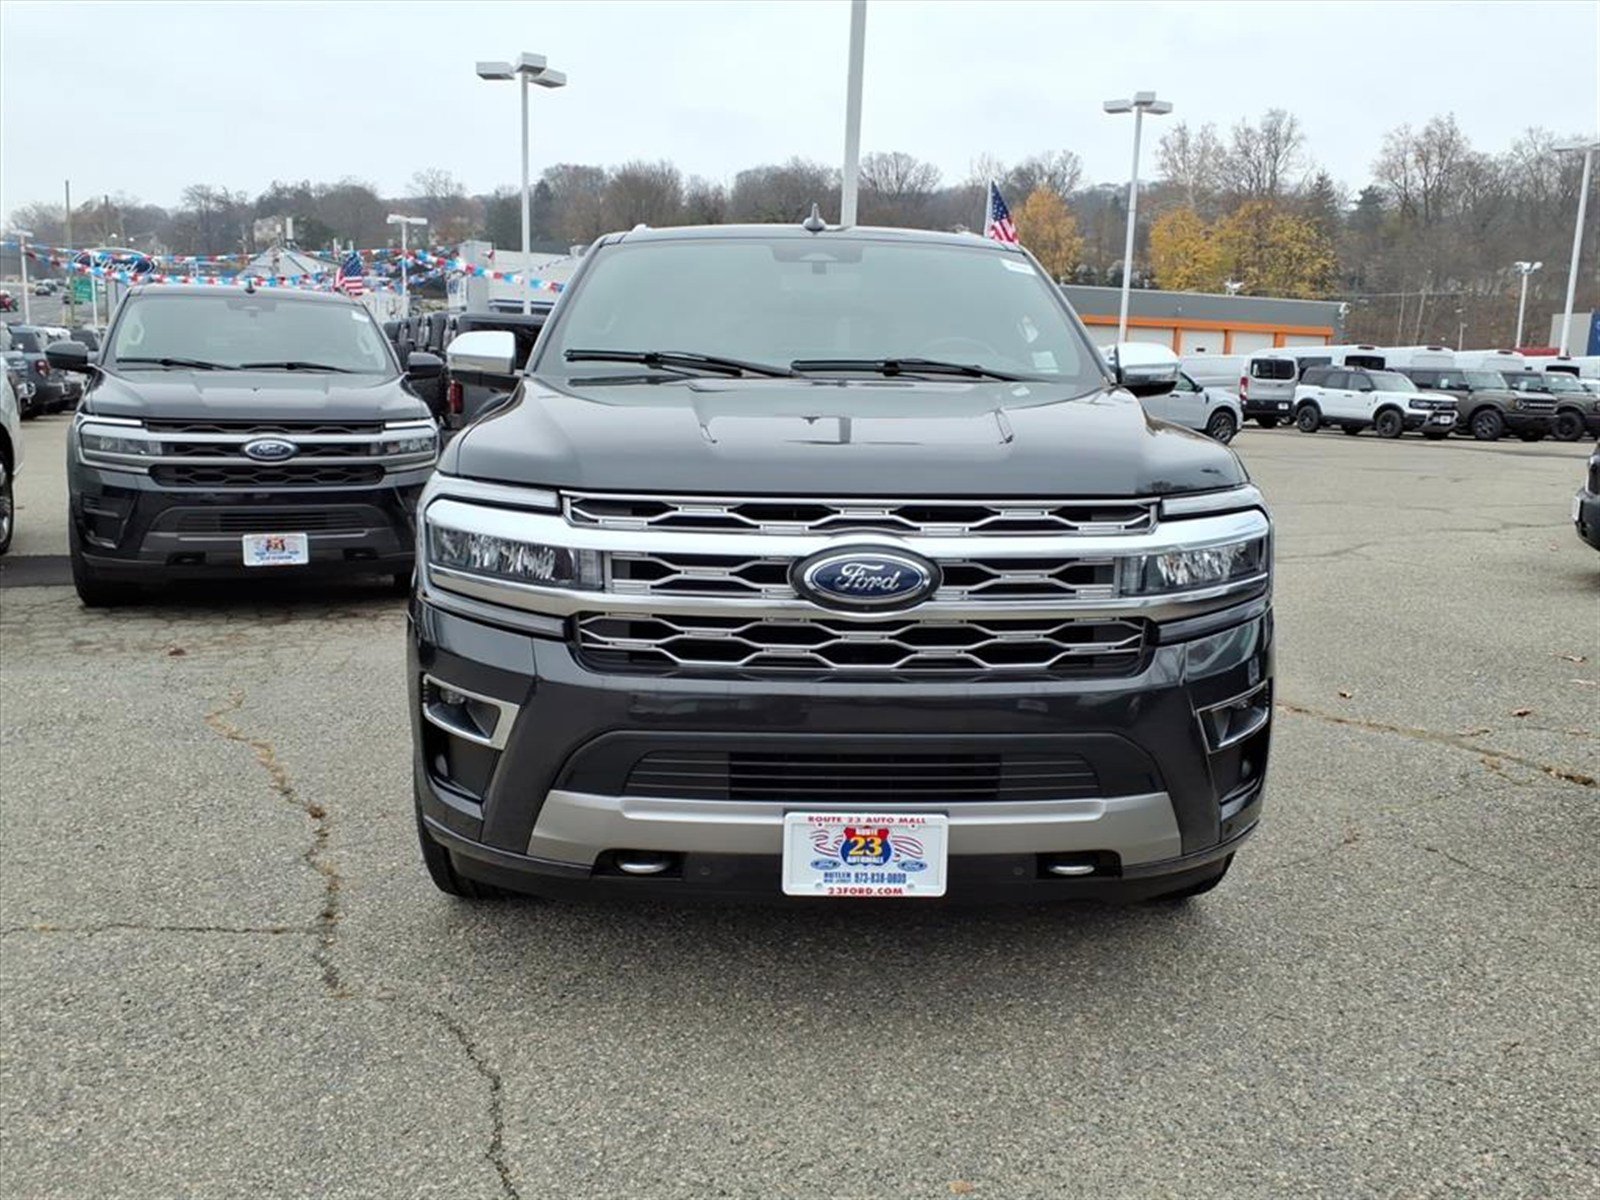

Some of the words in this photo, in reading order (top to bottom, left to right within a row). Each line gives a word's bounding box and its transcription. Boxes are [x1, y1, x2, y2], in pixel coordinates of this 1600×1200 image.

[836, 562, 901, 591] Ford
[849, 836, 883, 857] 23
[827, 887, 903, 895] 23FORD.COM
